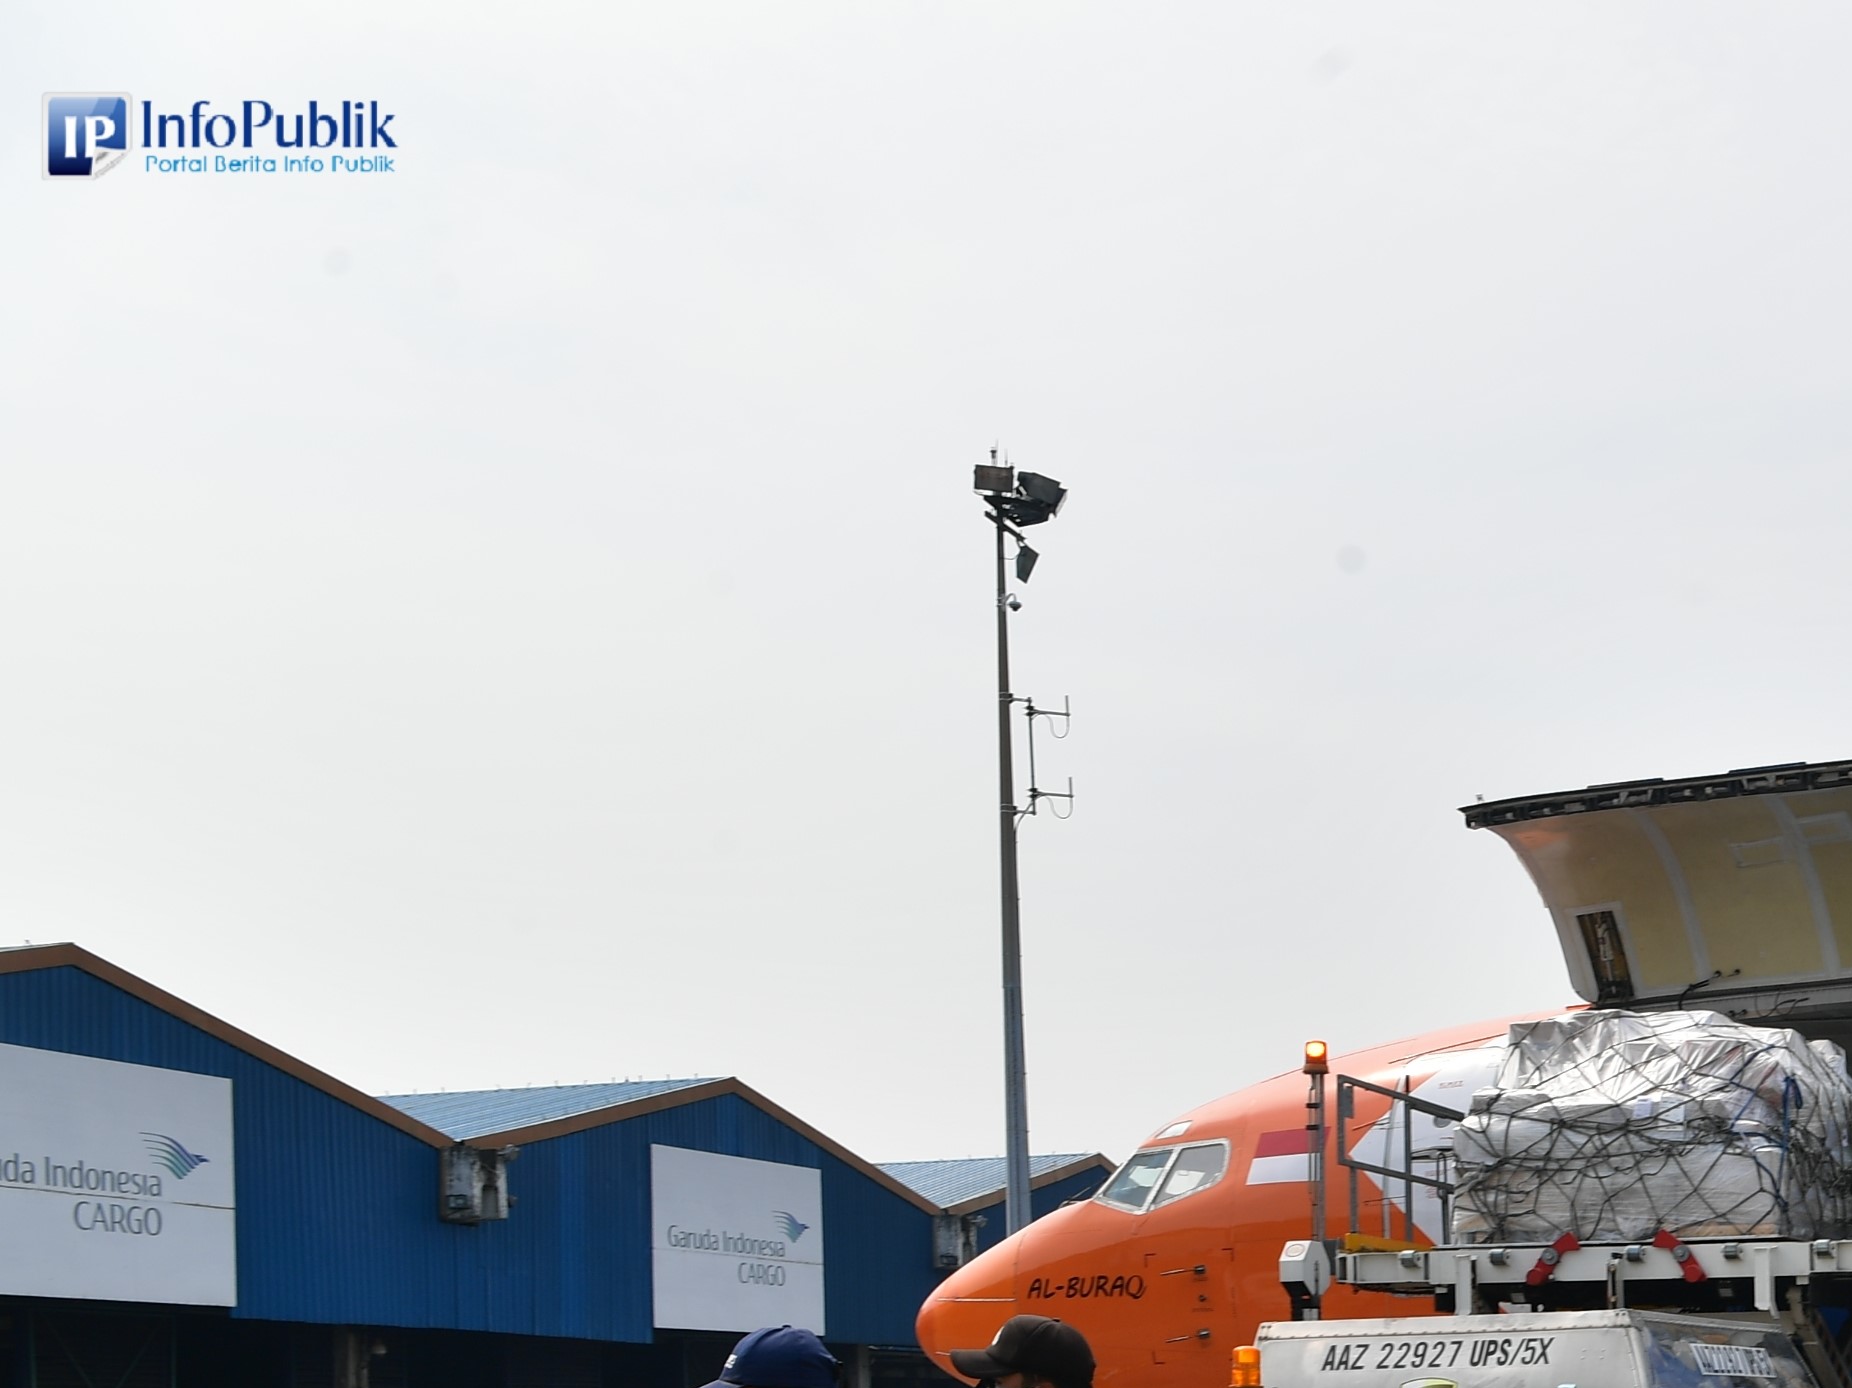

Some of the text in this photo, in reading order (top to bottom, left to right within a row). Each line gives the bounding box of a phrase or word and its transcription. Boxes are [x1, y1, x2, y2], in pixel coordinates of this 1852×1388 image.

[0, 1152, 163, 1198] da Indonesia
[73, 1200, 163, 1236] CARGO
[667, 1224, 786, 1257] Garuda Indonesia
[738, 1262, 786, 1287] CARGO
[1026, 1274, 1148, 1300] AL-BURAQ
[1320, 1336, 1556, 1372] AAZ 22927 UPS/5X
